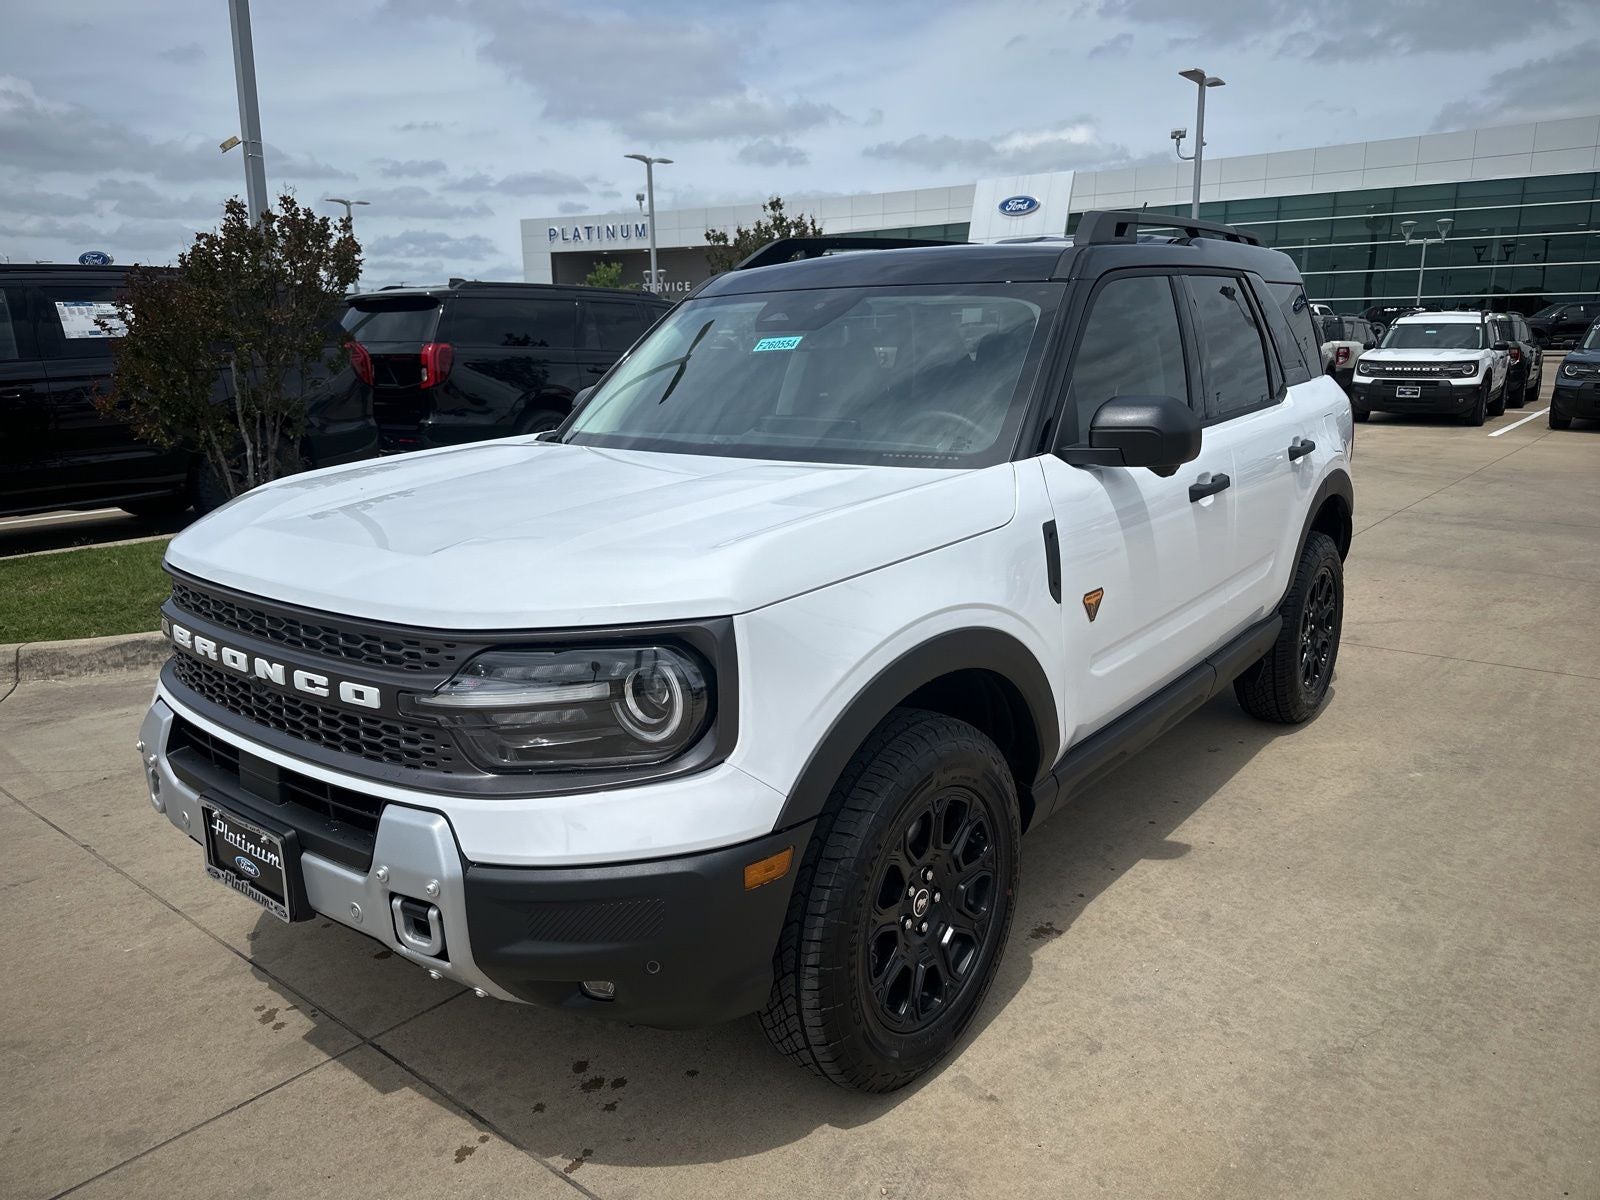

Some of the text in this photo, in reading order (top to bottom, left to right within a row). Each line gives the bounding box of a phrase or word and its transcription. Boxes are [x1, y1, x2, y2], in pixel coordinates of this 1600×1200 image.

[1005, 199, 1029, 211] Ford
[548, 223, 647, 243] PLATINUM
[756, 339, 797, 350] F260554
[173, 624, 381, 709] BRONCO
[211, 818, 283, 870] Platinum
[224, 871, 274, 912] Platinum
